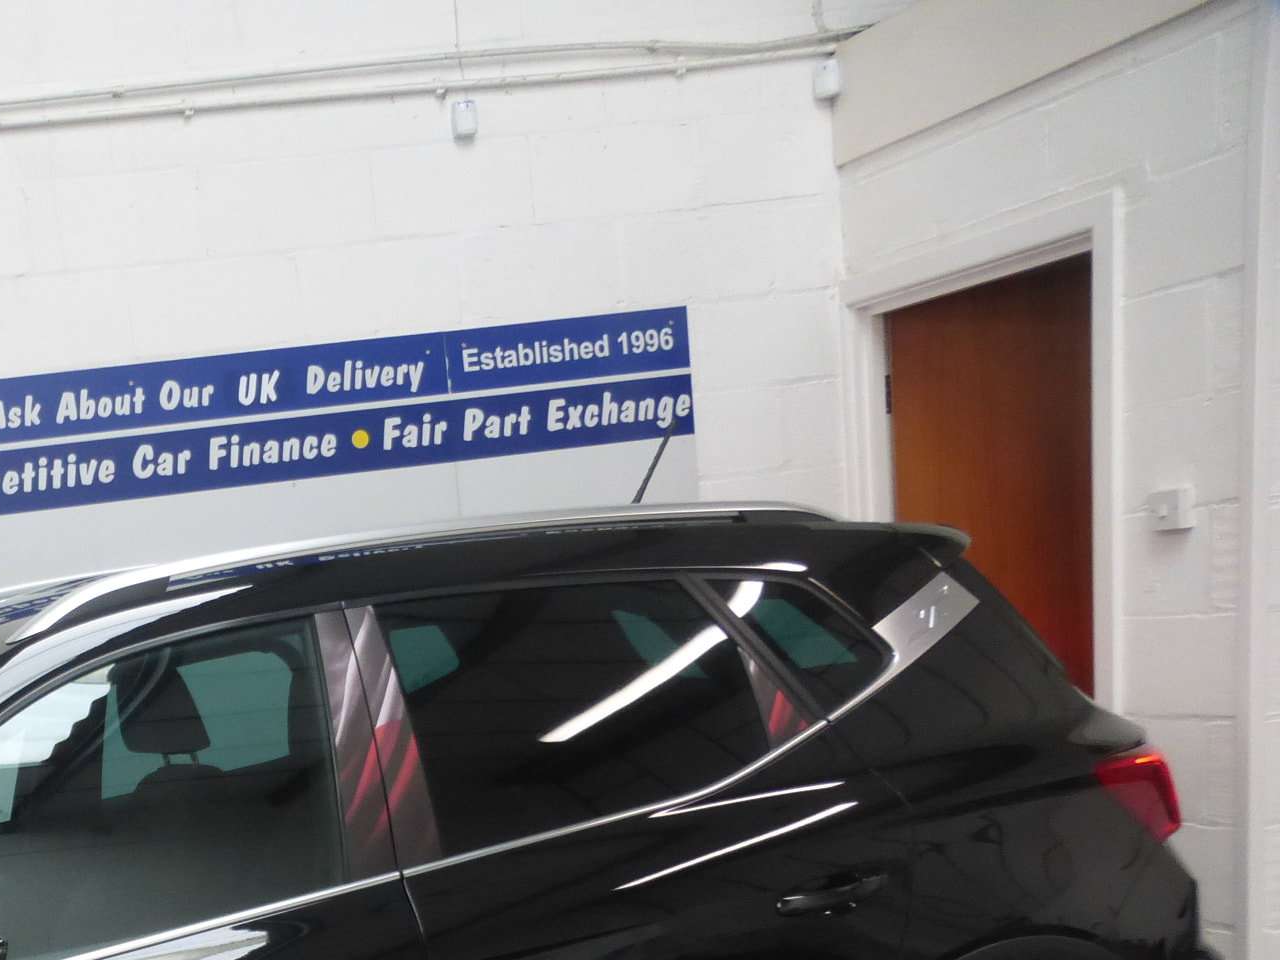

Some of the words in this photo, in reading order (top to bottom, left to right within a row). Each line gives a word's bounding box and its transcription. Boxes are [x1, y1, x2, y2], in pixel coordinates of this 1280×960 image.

[461, 334, 609, 373] Established
[617, 327, 674, 355] 1996
[56, 386, 146, 424] About
[159, 380, 214, 411] Our
[238, 369, 280, 406] UK
[306, 359, 424, 395] Delivery
[383, 413, 448, 451] Fair
[463, 406, 531, 441] Part
[546, 391, 692, 433] Exchange
[132, 444, 191, 480] Car
[209, 433, 337, 471] Finance
